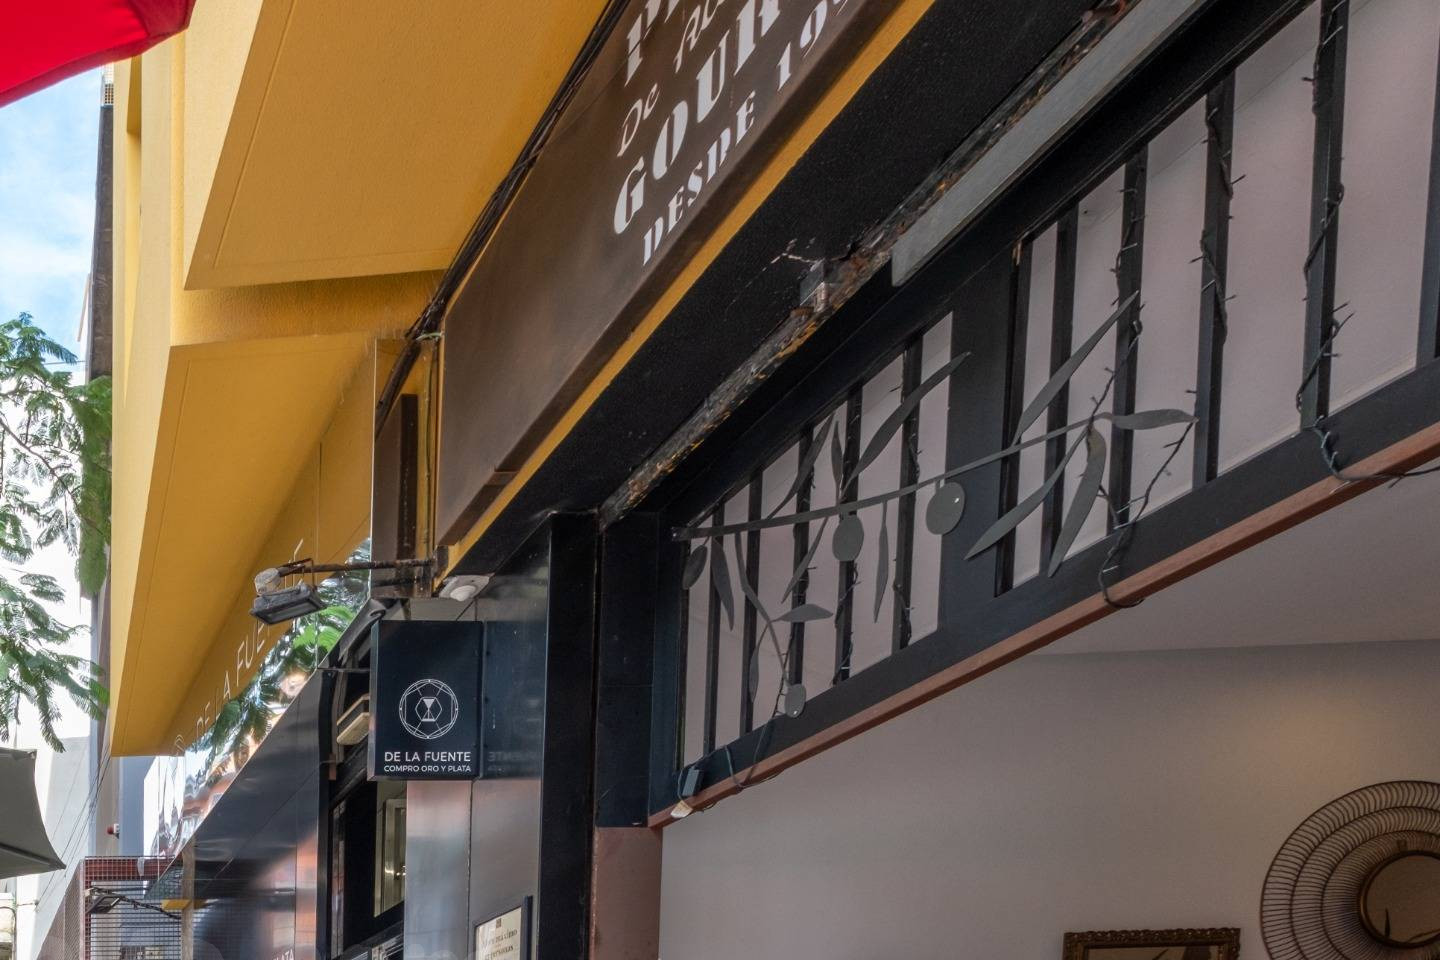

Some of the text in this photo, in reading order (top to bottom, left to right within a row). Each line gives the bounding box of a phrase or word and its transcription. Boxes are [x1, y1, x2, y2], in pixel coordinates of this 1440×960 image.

[642, 90, 756, 267] DESDE
[384, 751, 471, 762] DE LA FUENTE
[383, 765, 420, 773] COMPRO
